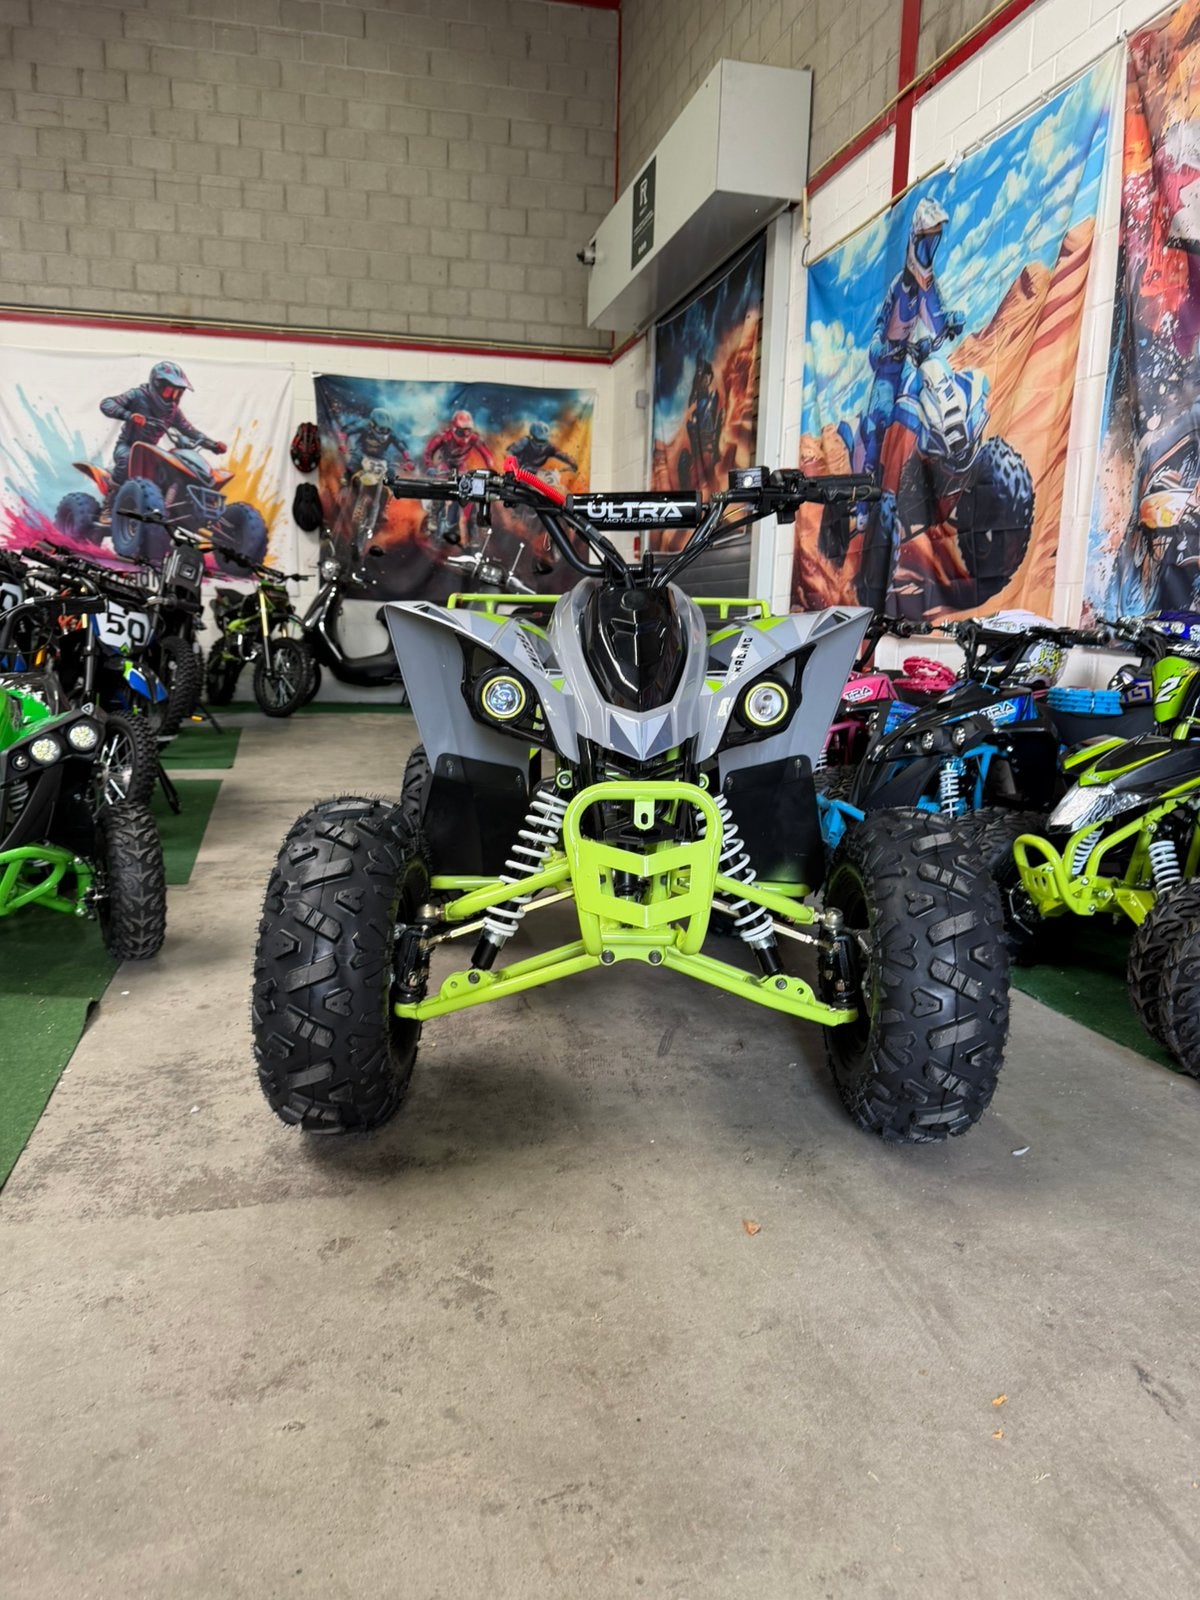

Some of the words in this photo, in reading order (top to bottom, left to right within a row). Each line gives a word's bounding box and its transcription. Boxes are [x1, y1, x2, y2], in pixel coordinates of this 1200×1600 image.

[587, 501, 683, 519] ULTRA
[106, 611, 145, 644] 50
[1154, 675, 1182, 704] 2
